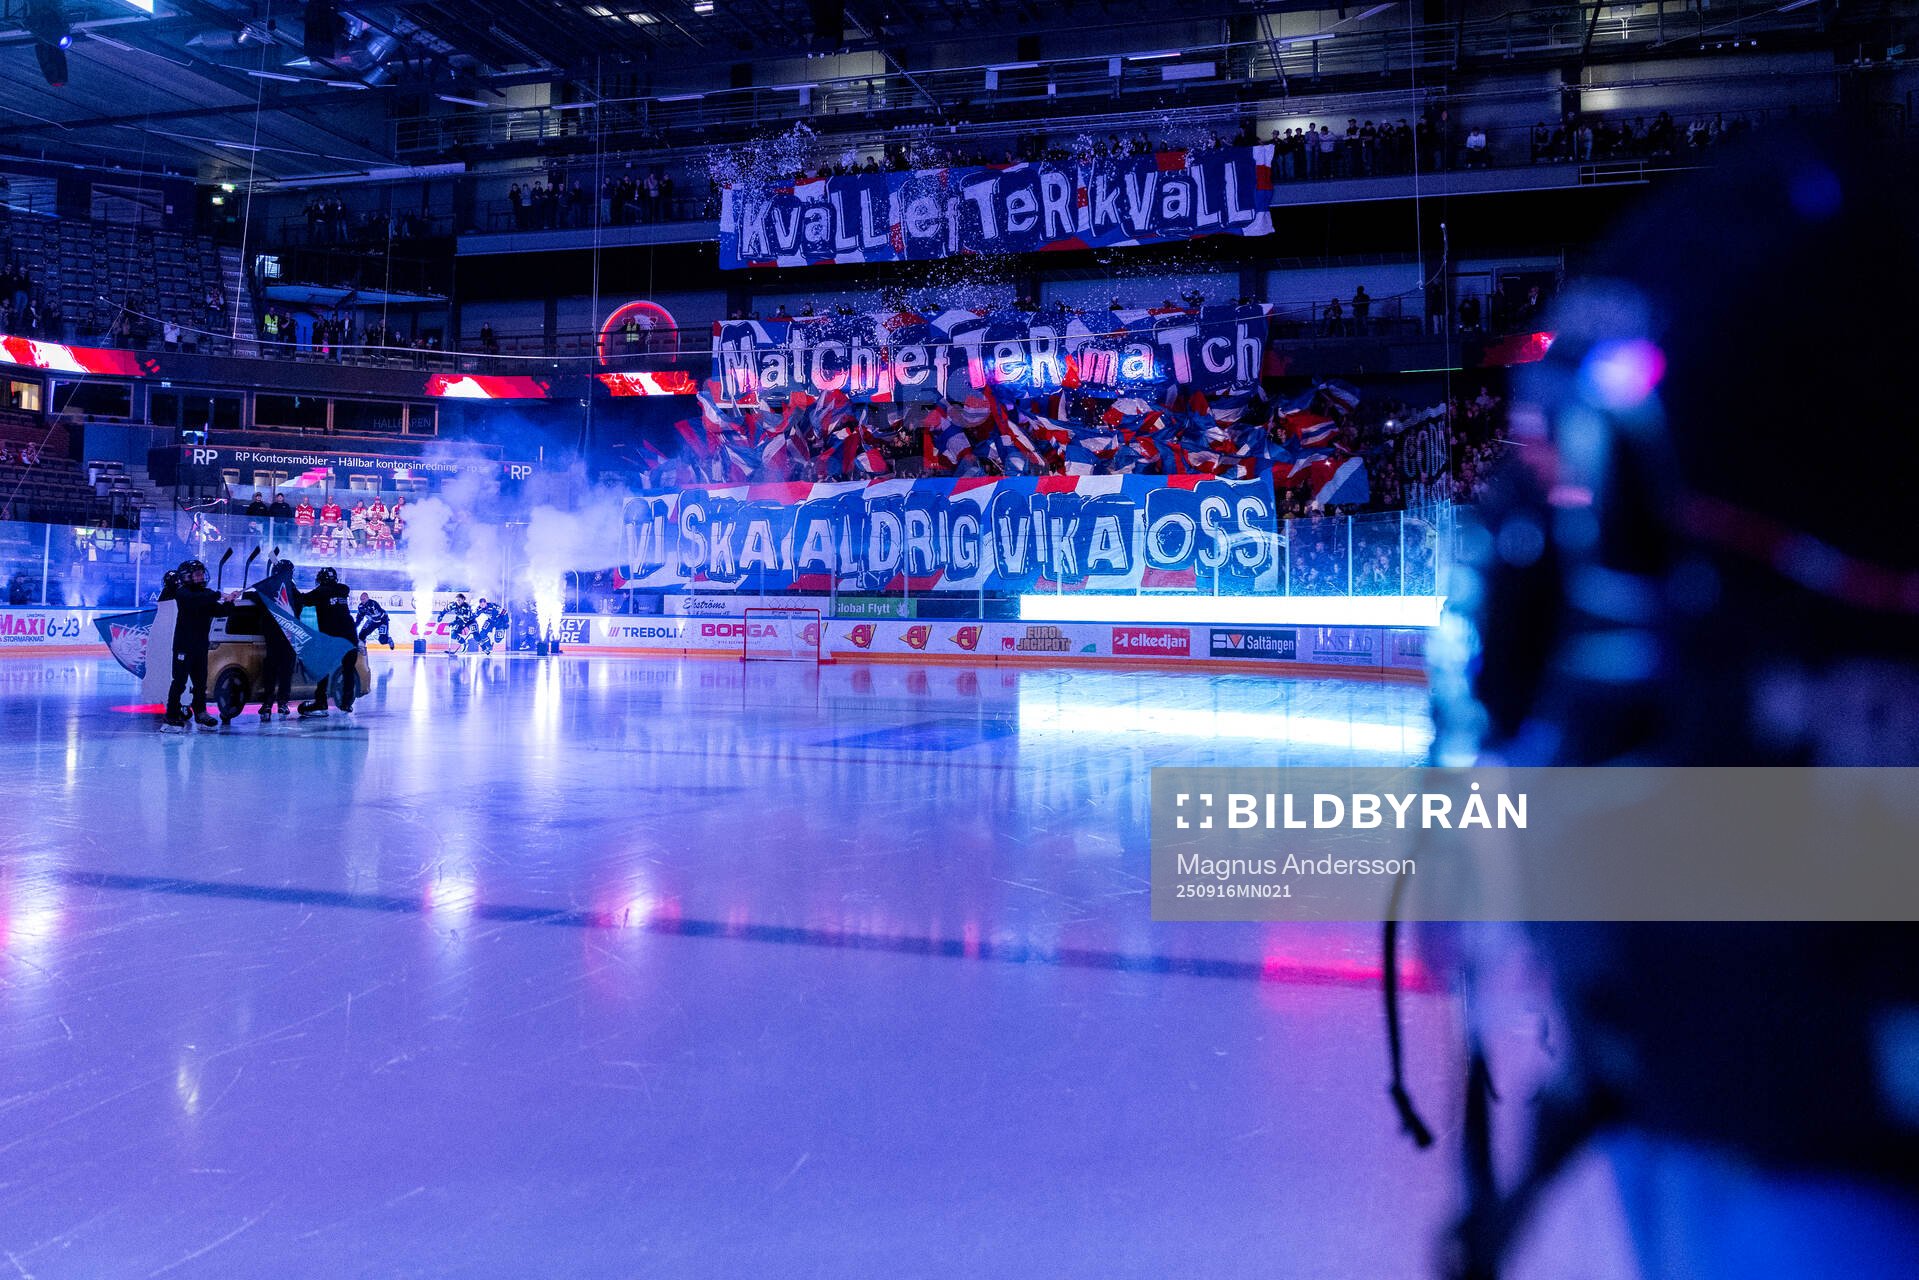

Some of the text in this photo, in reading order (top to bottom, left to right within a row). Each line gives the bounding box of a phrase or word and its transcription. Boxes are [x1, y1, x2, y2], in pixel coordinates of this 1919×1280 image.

[193, 449, 218, 465] RP
[235, 452, 250, 462] RP
[252, 452, 328, 466] Kontorsmöbler
[338, 456, 374, 468] Hållbar
[376, 457, 457, 473] kontorsinredning
[511, 465, 532, 480] RP
[680, 506, 779, 578] SKA
[796, 508, 979, 574] ALDRIG
[999, 508, 1129, 575] VIKA
[1147, 495, 1269, 569] OSS
[868, 603, 890, 615] Flytt
[47, 617, 80, 637] 6-23
[623, 627, 684, 639] TREBOLI
[701, 623, 778, 638] BORGA
[1130, 633, 1187, 650] elkedjan
[1246, 635, 1294, 654] Saltängen
